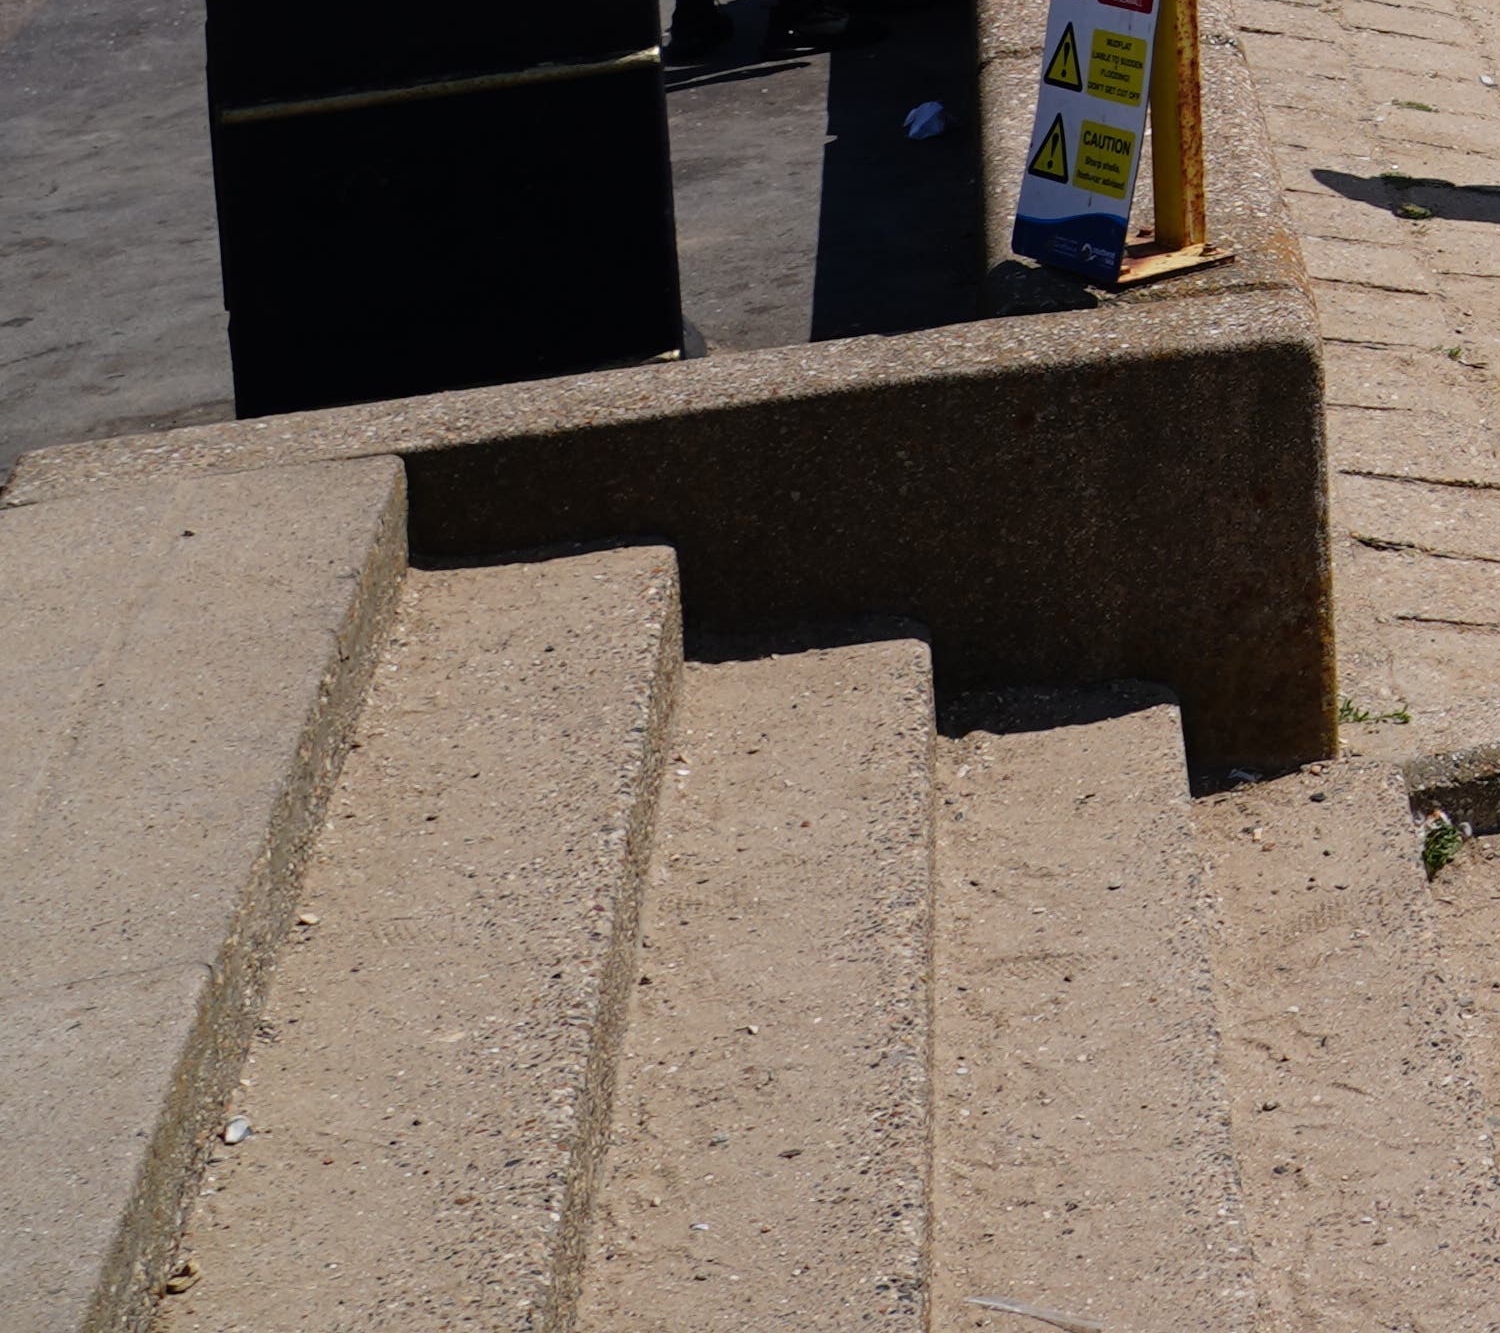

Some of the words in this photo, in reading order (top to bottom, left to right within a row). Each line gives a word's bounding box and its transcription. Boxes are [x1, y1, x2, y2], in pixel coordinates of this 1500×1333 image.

[1092, 50, 1111, 62] LIABLE
[1105, 85, 1116, 94] GET
[1117, 88, 1128, 97] CUT
[1129, 91, 1141, 100] OFF
[1083, 131, 1131, 156] CAUTION
[1085, 156, 1102, 169] Sharp
